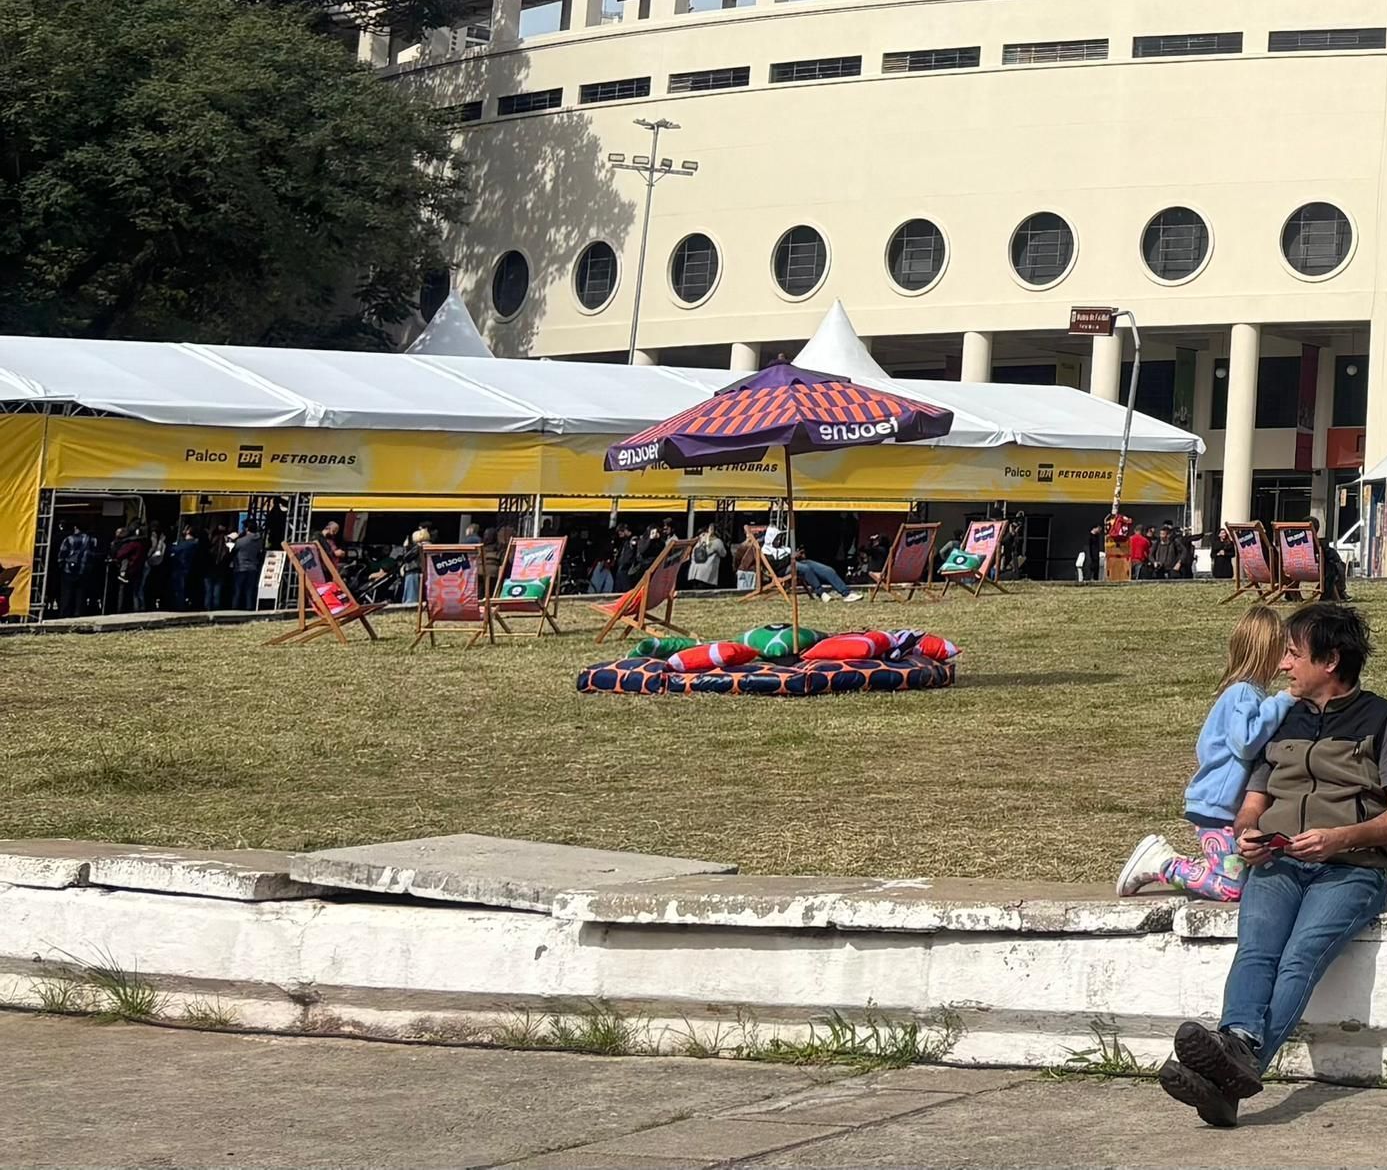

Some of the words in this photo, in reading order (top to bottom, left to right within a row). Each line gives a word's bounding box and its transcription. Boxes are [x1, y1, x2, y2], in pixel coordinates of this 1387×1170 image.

[819, 416, 900, 440] enjoei
[185, 449, 228, 463] Palco
[270, 453, 357, 465] PETROBRAS
[618, 437, 659, 466] enjoei
[1004, 466, 1032, 478] Palco
[1057, 470, 1113, 480] PETROBRAS
